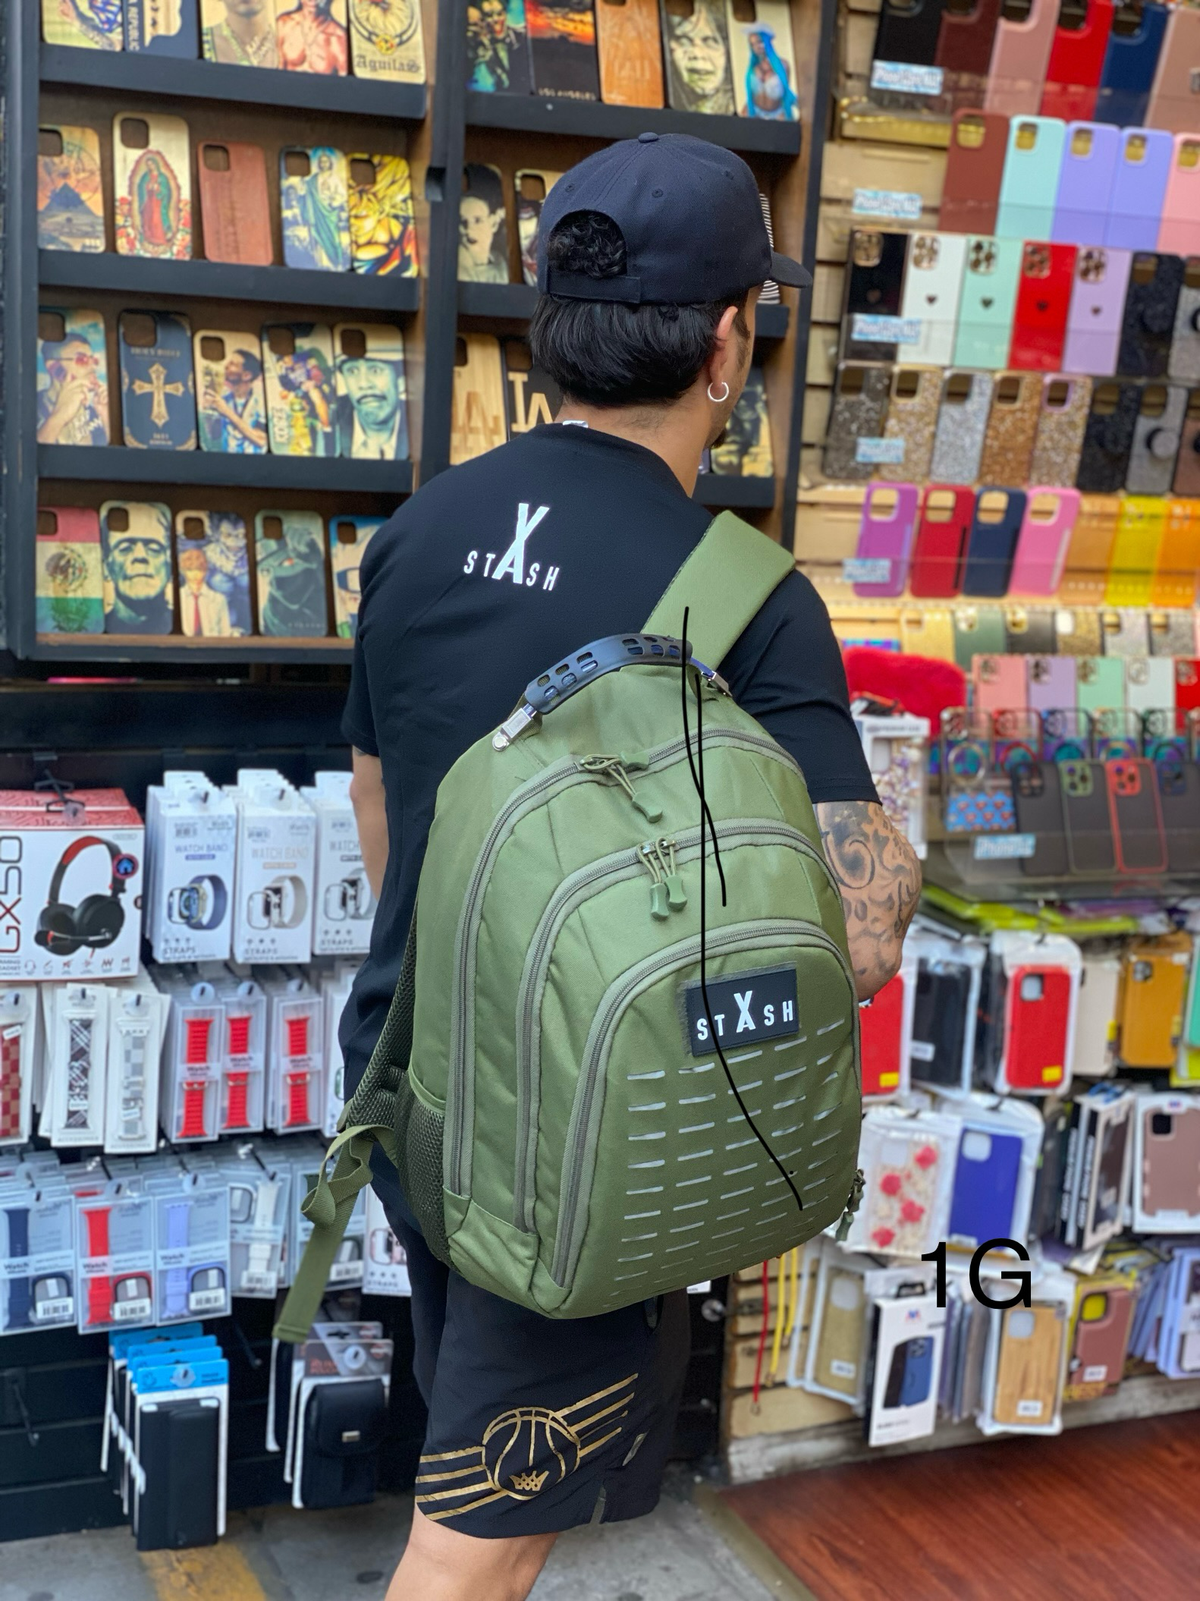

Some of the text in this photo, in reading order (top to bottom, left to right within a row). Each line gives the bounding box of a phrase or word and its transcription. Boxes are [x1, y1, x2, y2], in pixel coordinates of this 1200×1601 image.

[128, 6, 140, 51] REPUBLIC
[174, 842, 229, 853] WATCH BAND
[162, 946, 196, 955] STRAPS
[244, 947, 278, 956] STRAPS
